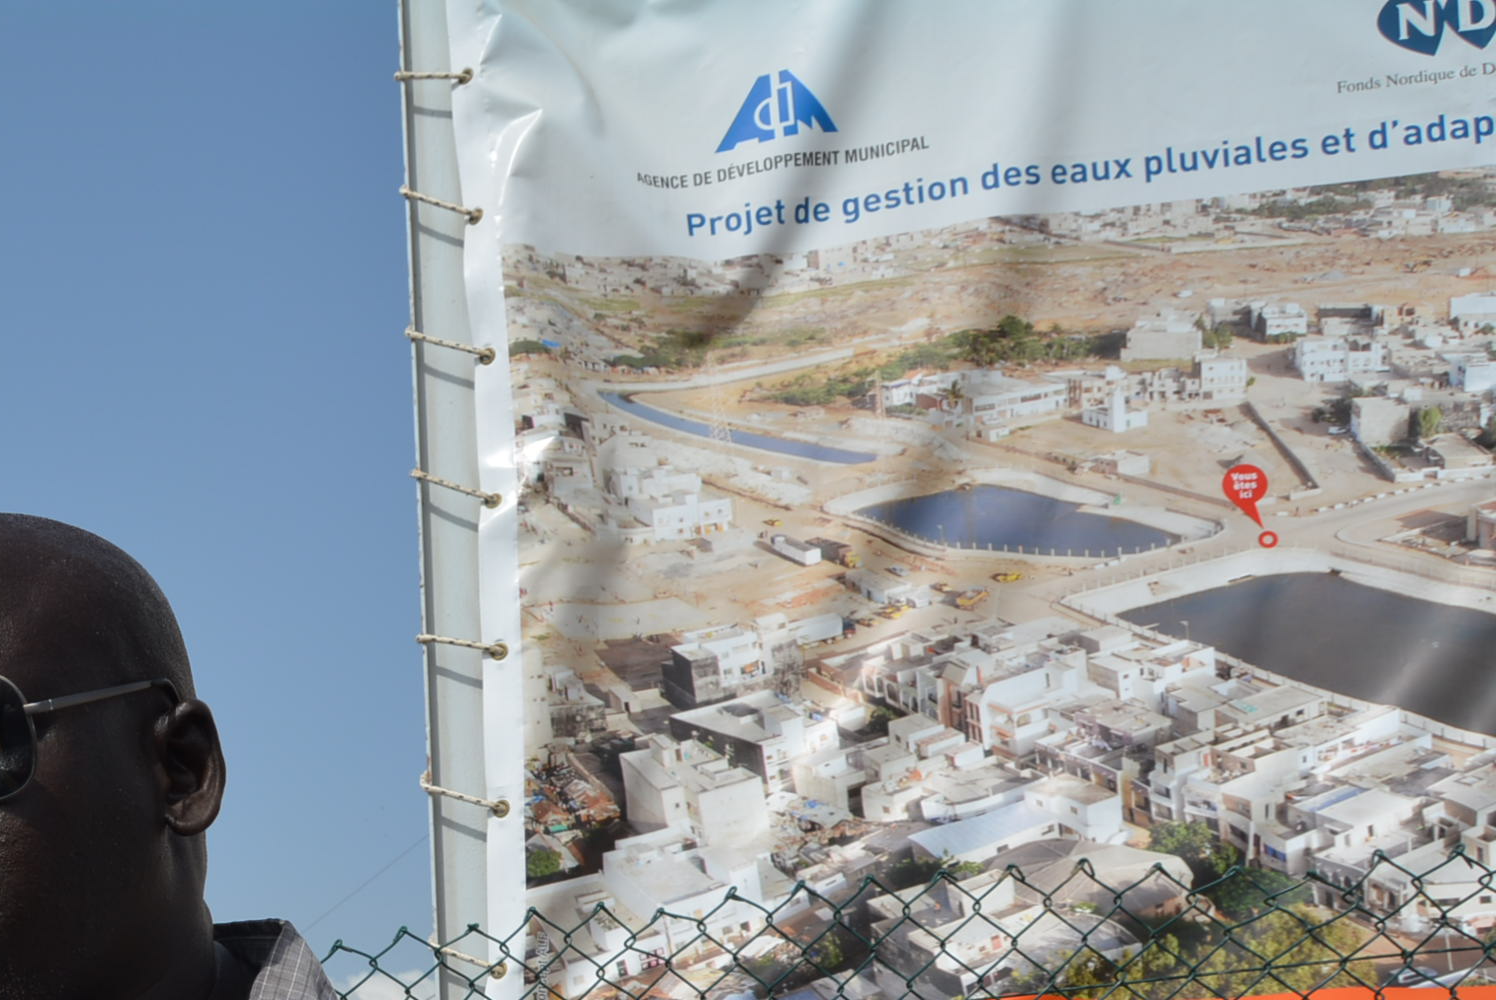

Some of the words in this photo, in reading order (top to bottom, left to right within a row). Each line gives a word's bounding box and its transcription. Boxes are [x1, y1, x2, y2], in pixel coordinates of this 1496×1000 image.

[1337, 77, 1381, 93] Fonds
[1386, 69, 1455, 88] Nordique
[1459, 65, 1477, 78] de
[637, 172, 688, 189] AGENCE
[693, 171, 713, 187] DE
[717, 150, 840, 182] DÉVELOPPEMENT
[845, 135, 930, 165] MUNICIPAL
[687, 200, 785, 237] Projet
[794, 197, 830, 223] de
[842, 177, 969, 223] gestion
[981, 163, 1041, 191] des
[1051, 157, 1132, 184] eaux
[1145, 140, 1309, 182] pluviales
[1320, 127, 1356, 155] et
[1230, 472, 1258, 481] Vous
[1233, 480, 1258, 491] êtes
[1240, 489, 1253, 499] ici
